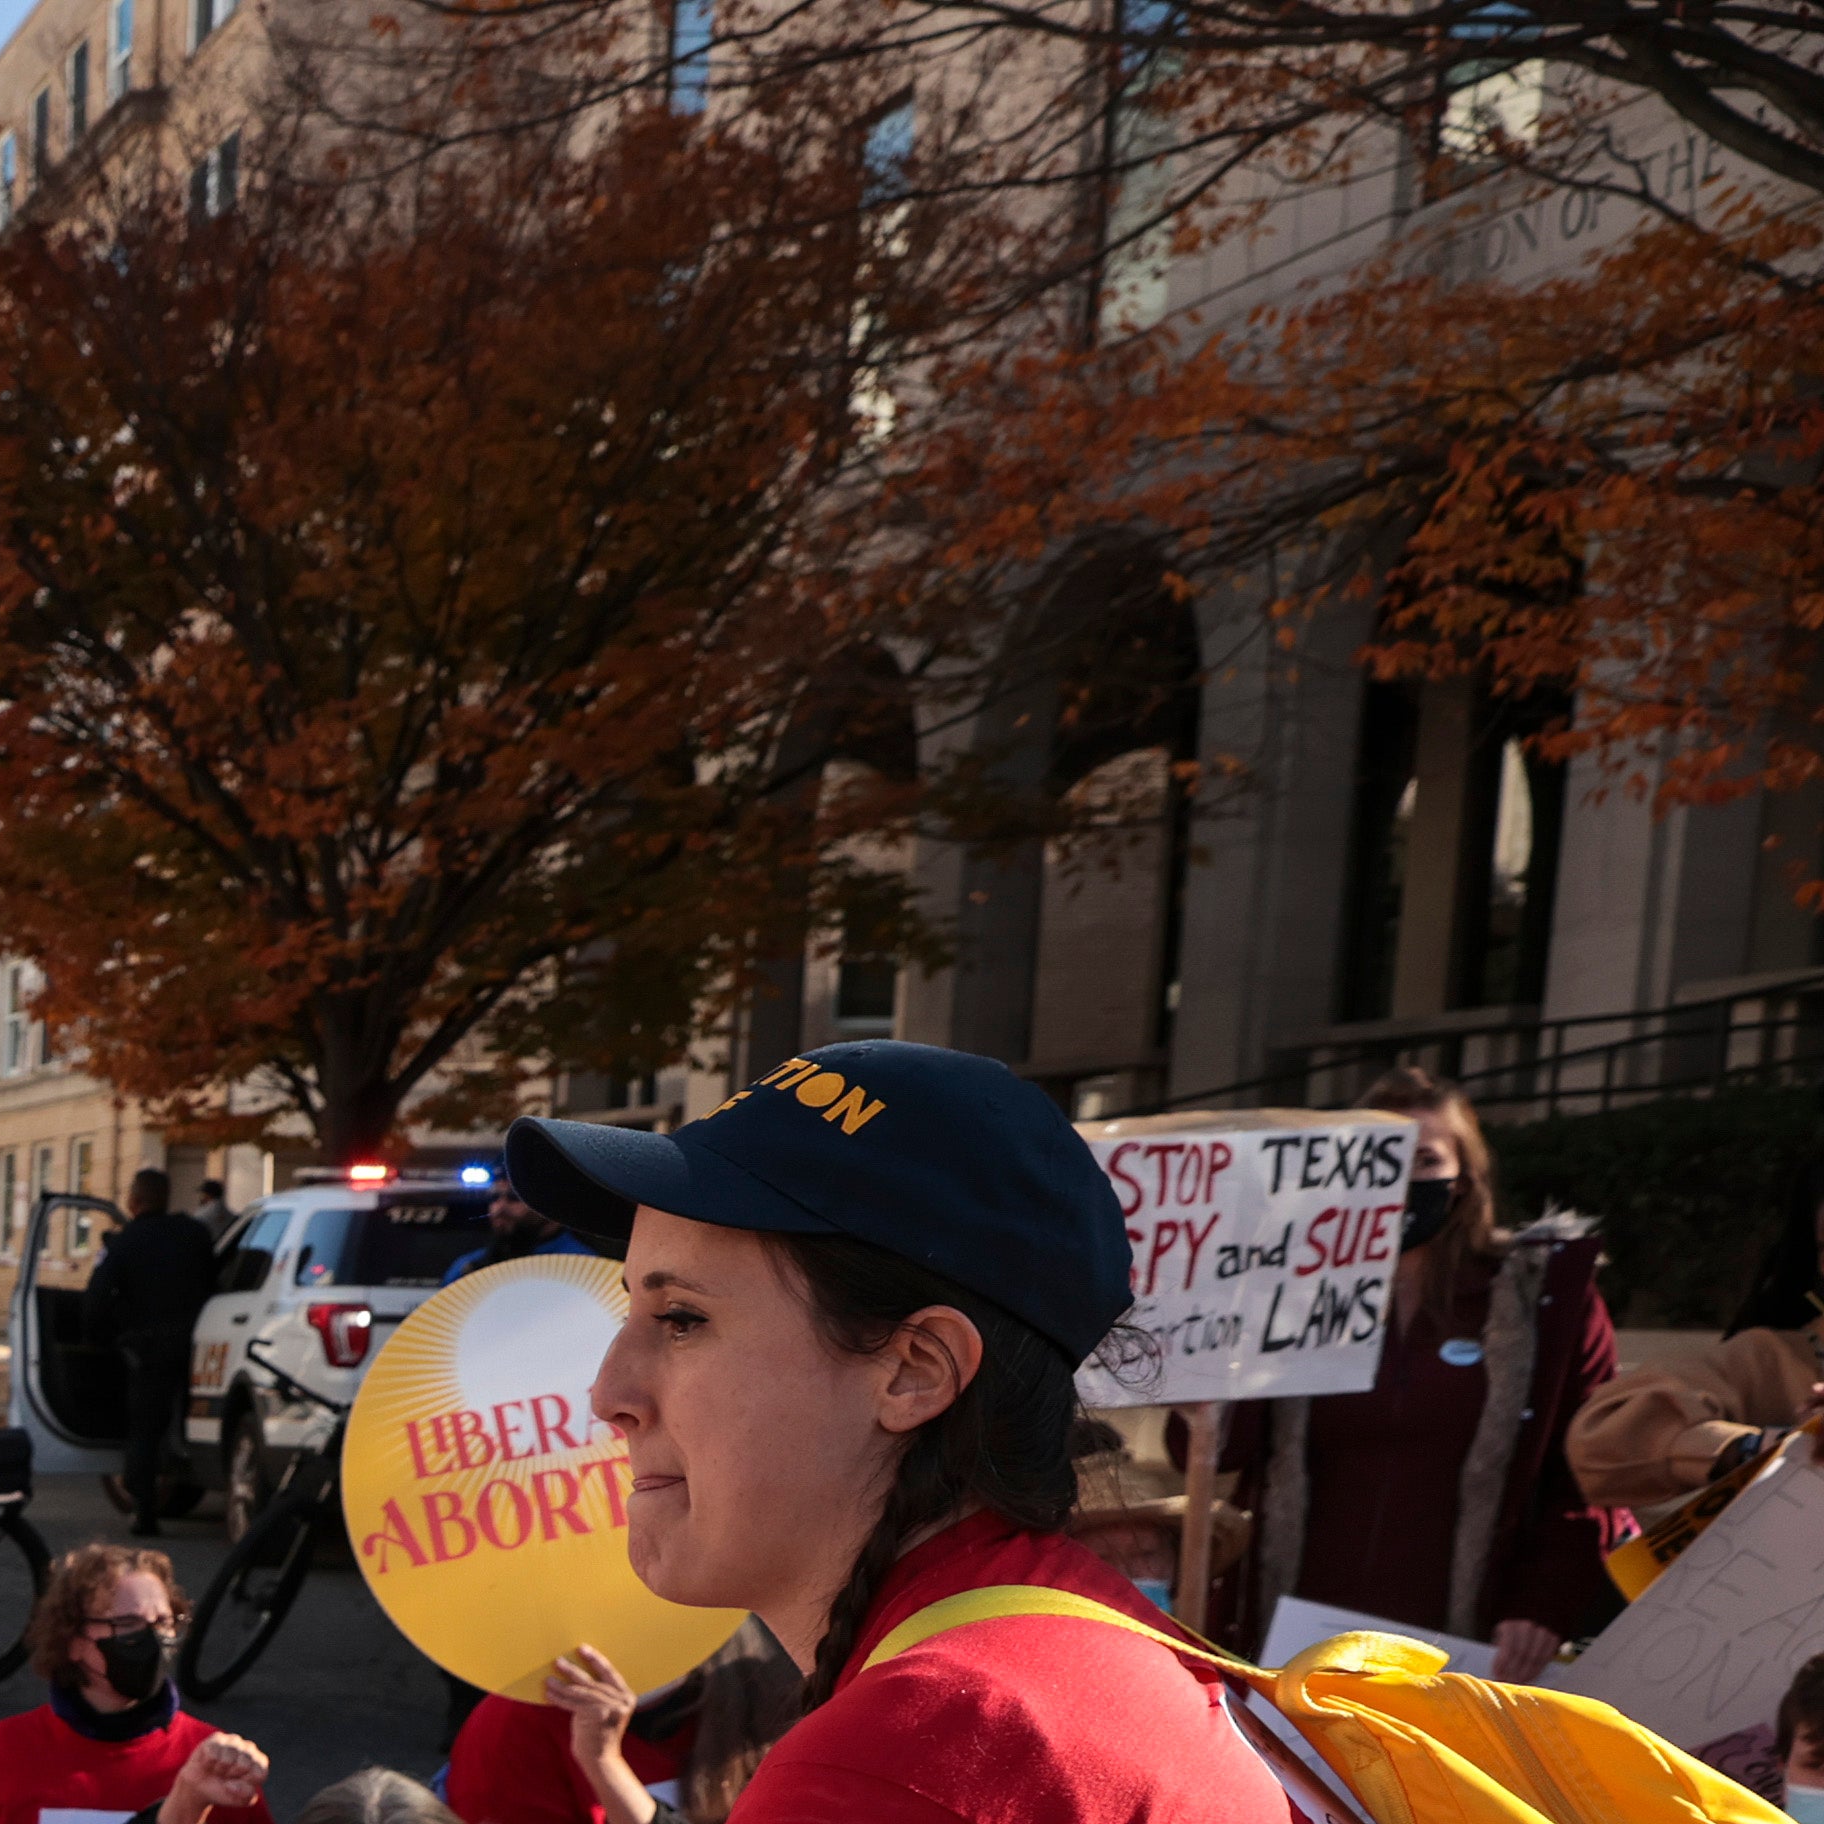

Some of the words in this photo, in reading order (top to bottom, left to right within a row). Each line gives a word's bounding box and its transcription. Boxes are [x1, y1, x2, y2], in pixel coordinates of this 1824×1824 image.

[759, 1057, 887, 1136] TION
[1108, 1141, 1232, 1218] STOP
[1261, 1134, 1405, 1194] TEXAS
[1217, 1221, 1293, 1280] and
[1294, 1204, 1403, 1277] SUE
[405, 1387, 629, 1480] LIBERA
[362, 1456, 631, 1575] ABORT
